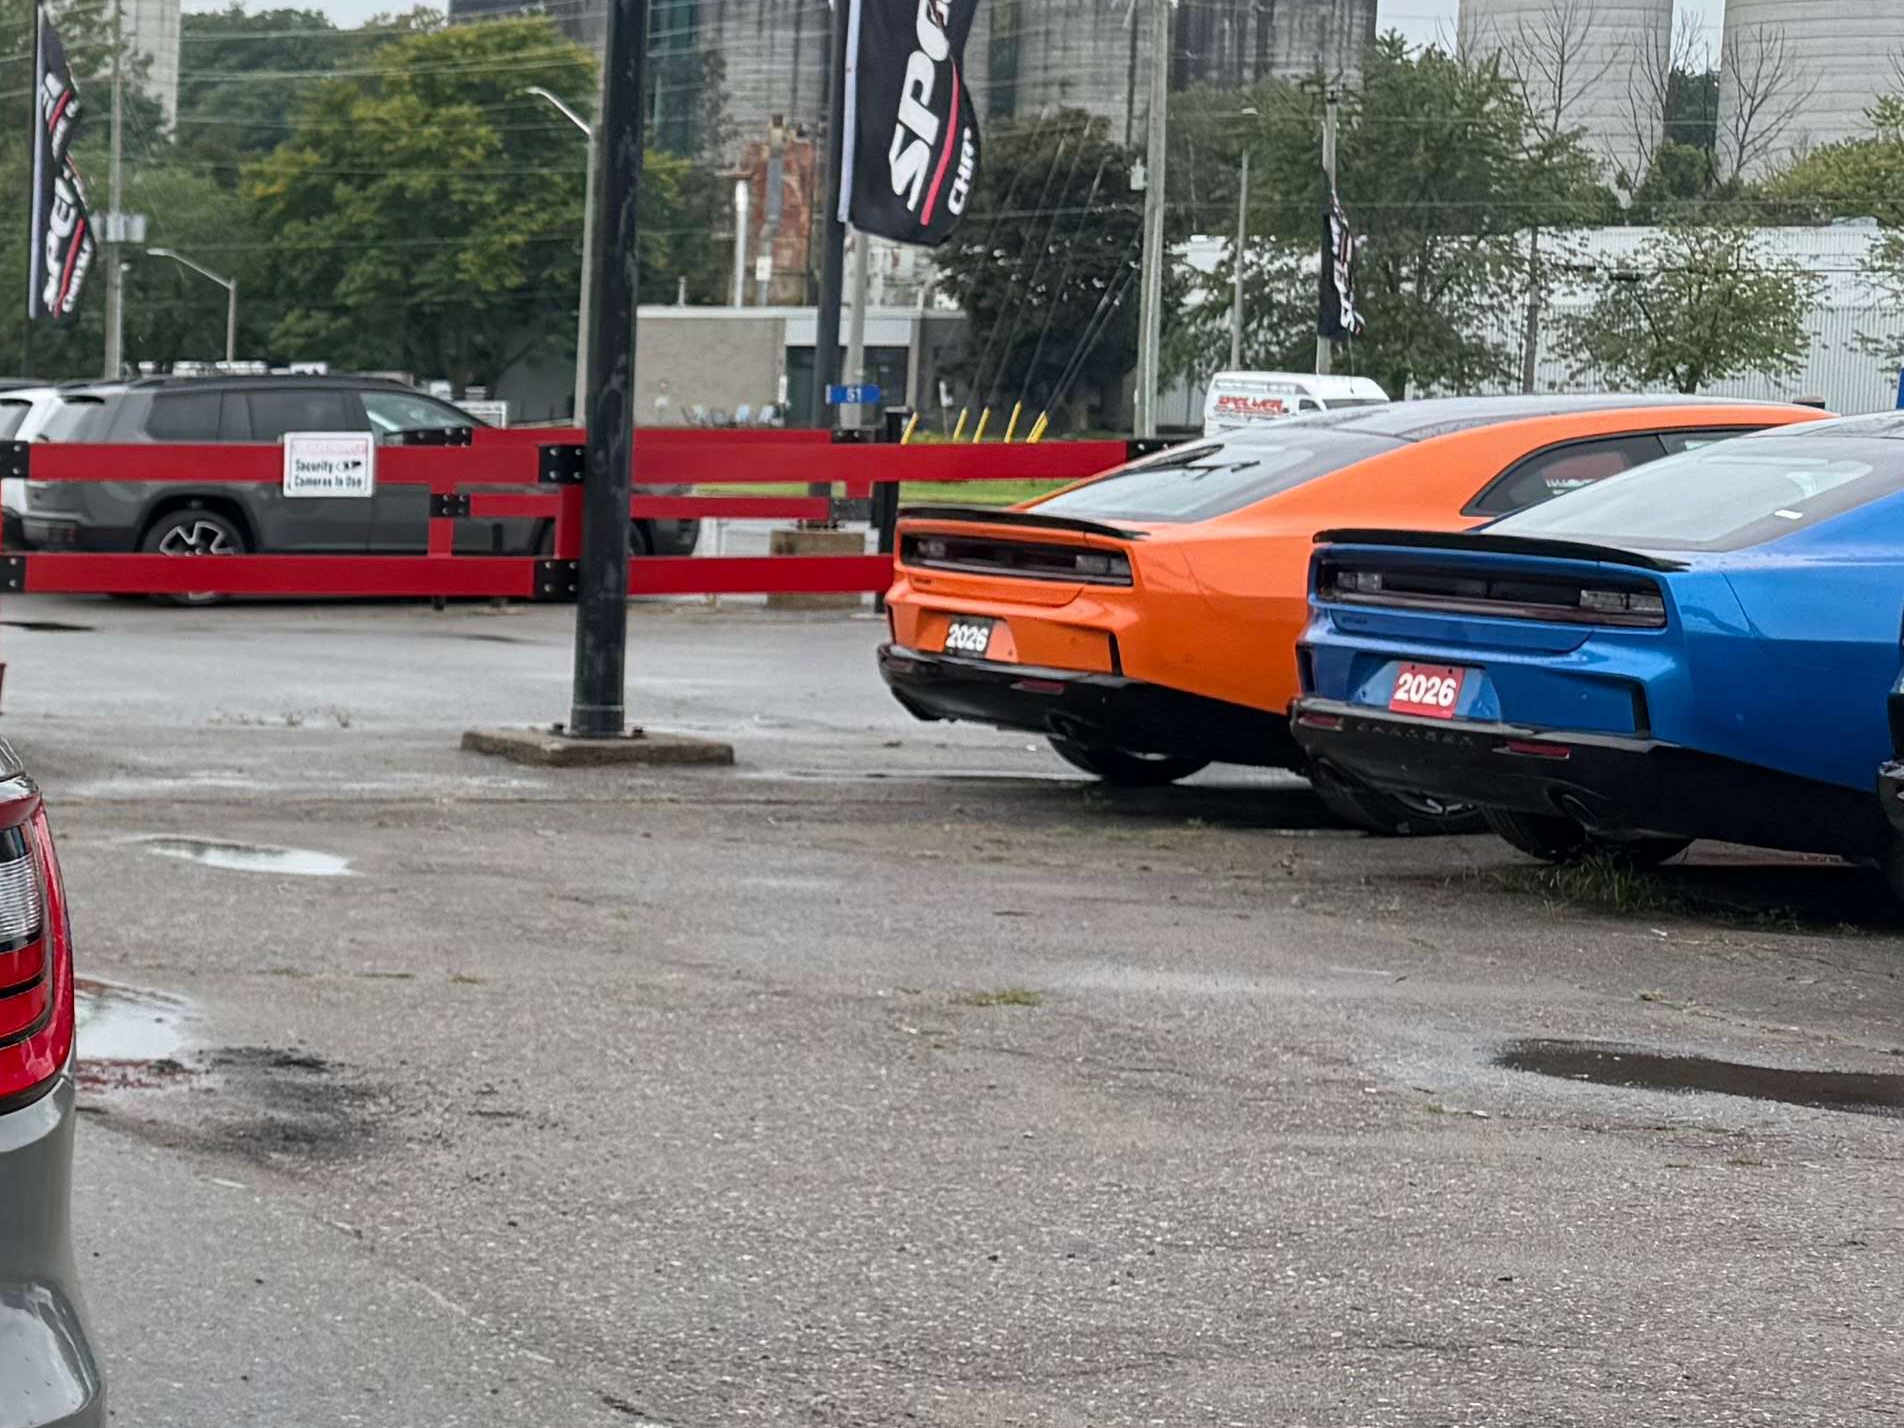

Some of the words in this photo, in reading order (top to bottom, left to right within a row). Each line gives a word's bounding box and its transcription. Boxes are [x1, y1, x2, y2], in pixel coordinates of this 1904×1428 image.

[295, 459, 333, 473] Security
[294, 475, 333, 487] Cameras
[945, 623, 989, 652] 2026
[1393, 672, 1457, 707] 2026
